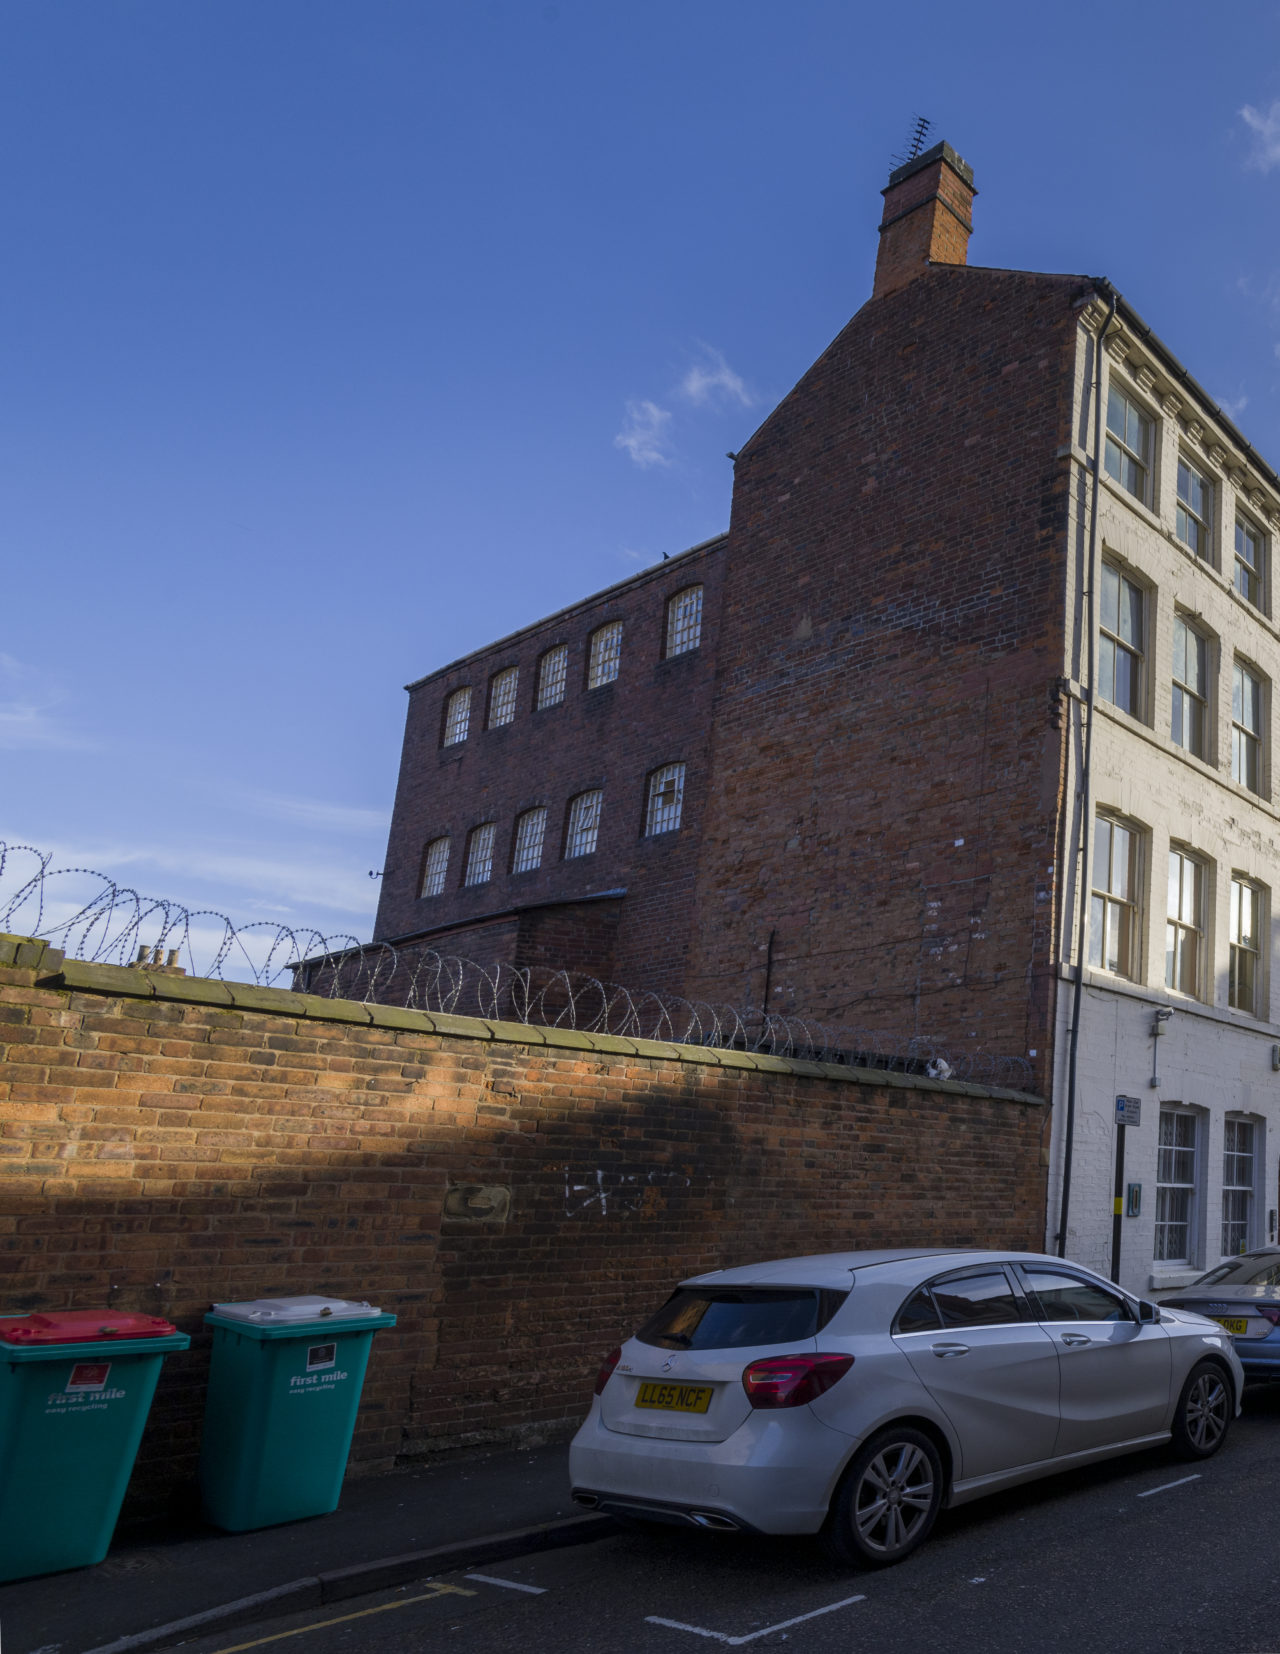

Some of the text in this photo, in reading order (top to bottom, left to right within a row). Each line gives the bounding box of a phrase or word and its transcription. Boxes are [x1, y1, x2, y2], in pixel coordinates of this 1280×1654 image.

[290, 1371, 348, 1386] first mile
[47, 1388, 126, 1405] first mile
[640, 1385, 706, 1407] LL65 NCF
[68, 1403, 108, 1412] recycling
